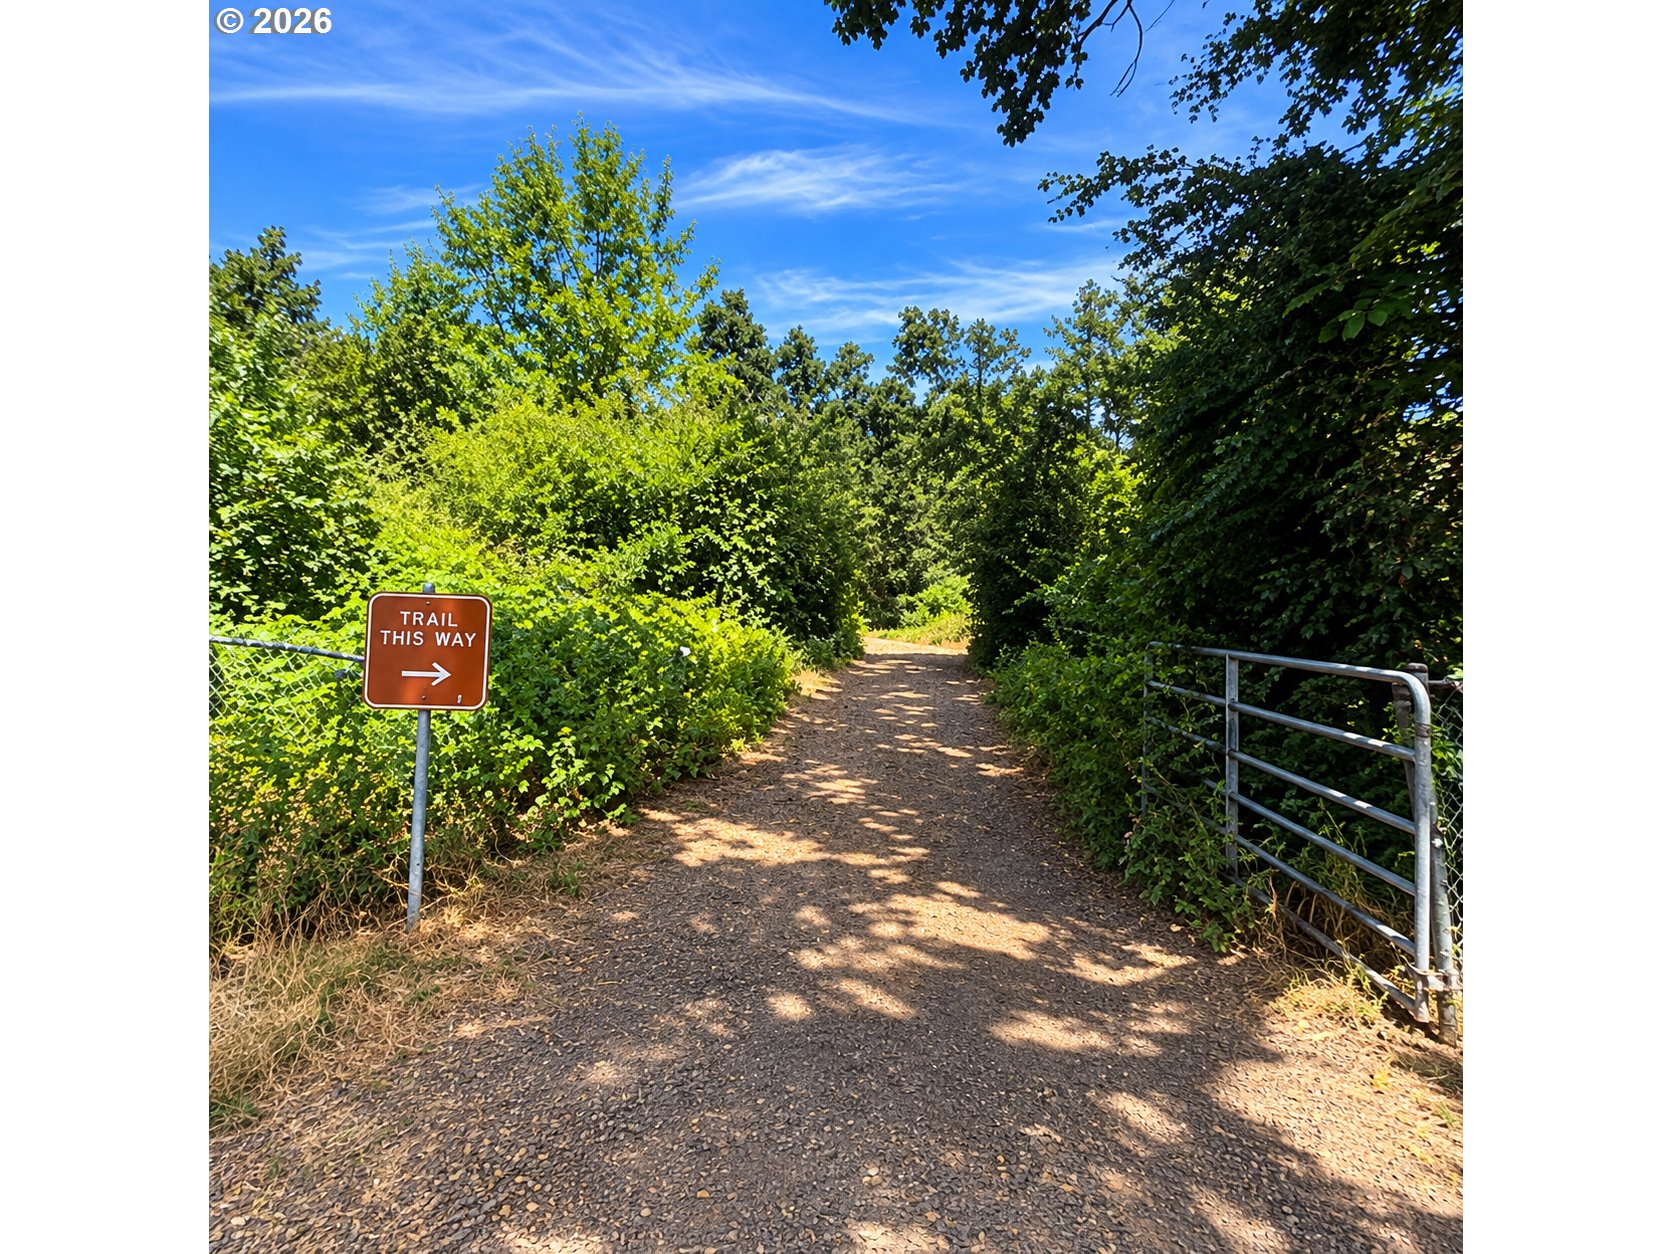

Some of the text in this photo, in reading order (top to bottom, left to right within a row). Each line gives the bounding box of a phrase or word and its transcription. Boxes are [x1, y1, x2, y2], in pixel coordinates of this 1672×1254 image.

[400, 611, 458, 627] TRAIL
[380, 630, 477, 647] THIS WAY
